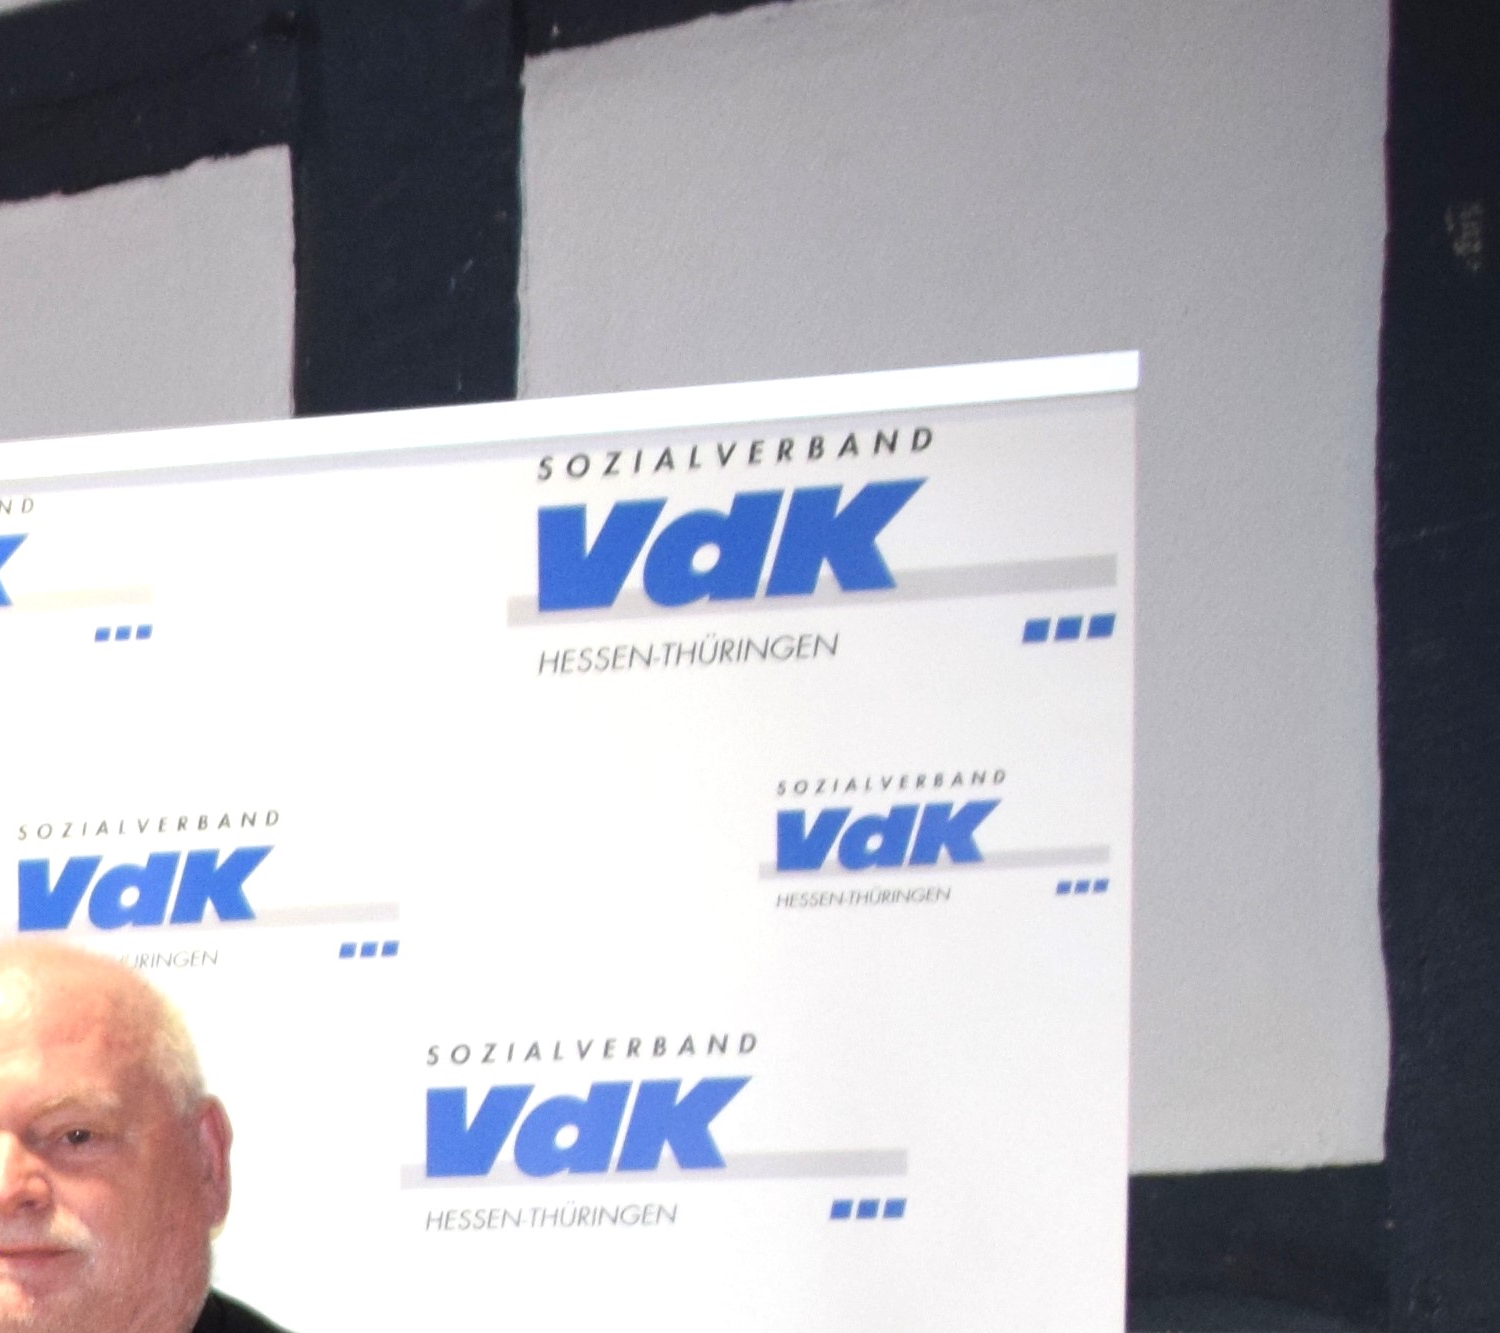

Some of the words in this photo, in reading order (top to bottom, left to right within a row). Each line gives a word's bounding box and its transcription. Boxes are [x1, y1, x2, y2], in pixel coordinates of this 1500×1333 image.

[538, 425, 934, 481] SOZIALVERBAND
[537, 478, 928, 612] VdK
[538, 632, 840, 674] HESSEN-THÜRINGEN
[777, 768, 1006, 796] SOZIALVERBAND
[18, 810, 279, 841] SOZIALVERBAND
[776, 799, 1001, 872] VdK
[18, 845, 274, 931] VdK
[776, 887, 952, 908] HESSEN-THÜRINGEN
[427, 1033, 757, 1066] SOZIALVERBAND
[425, 1076, 752, 1178] VdK
[426, 1203, 678, 1231] HESSEN-THÜRINGEN
